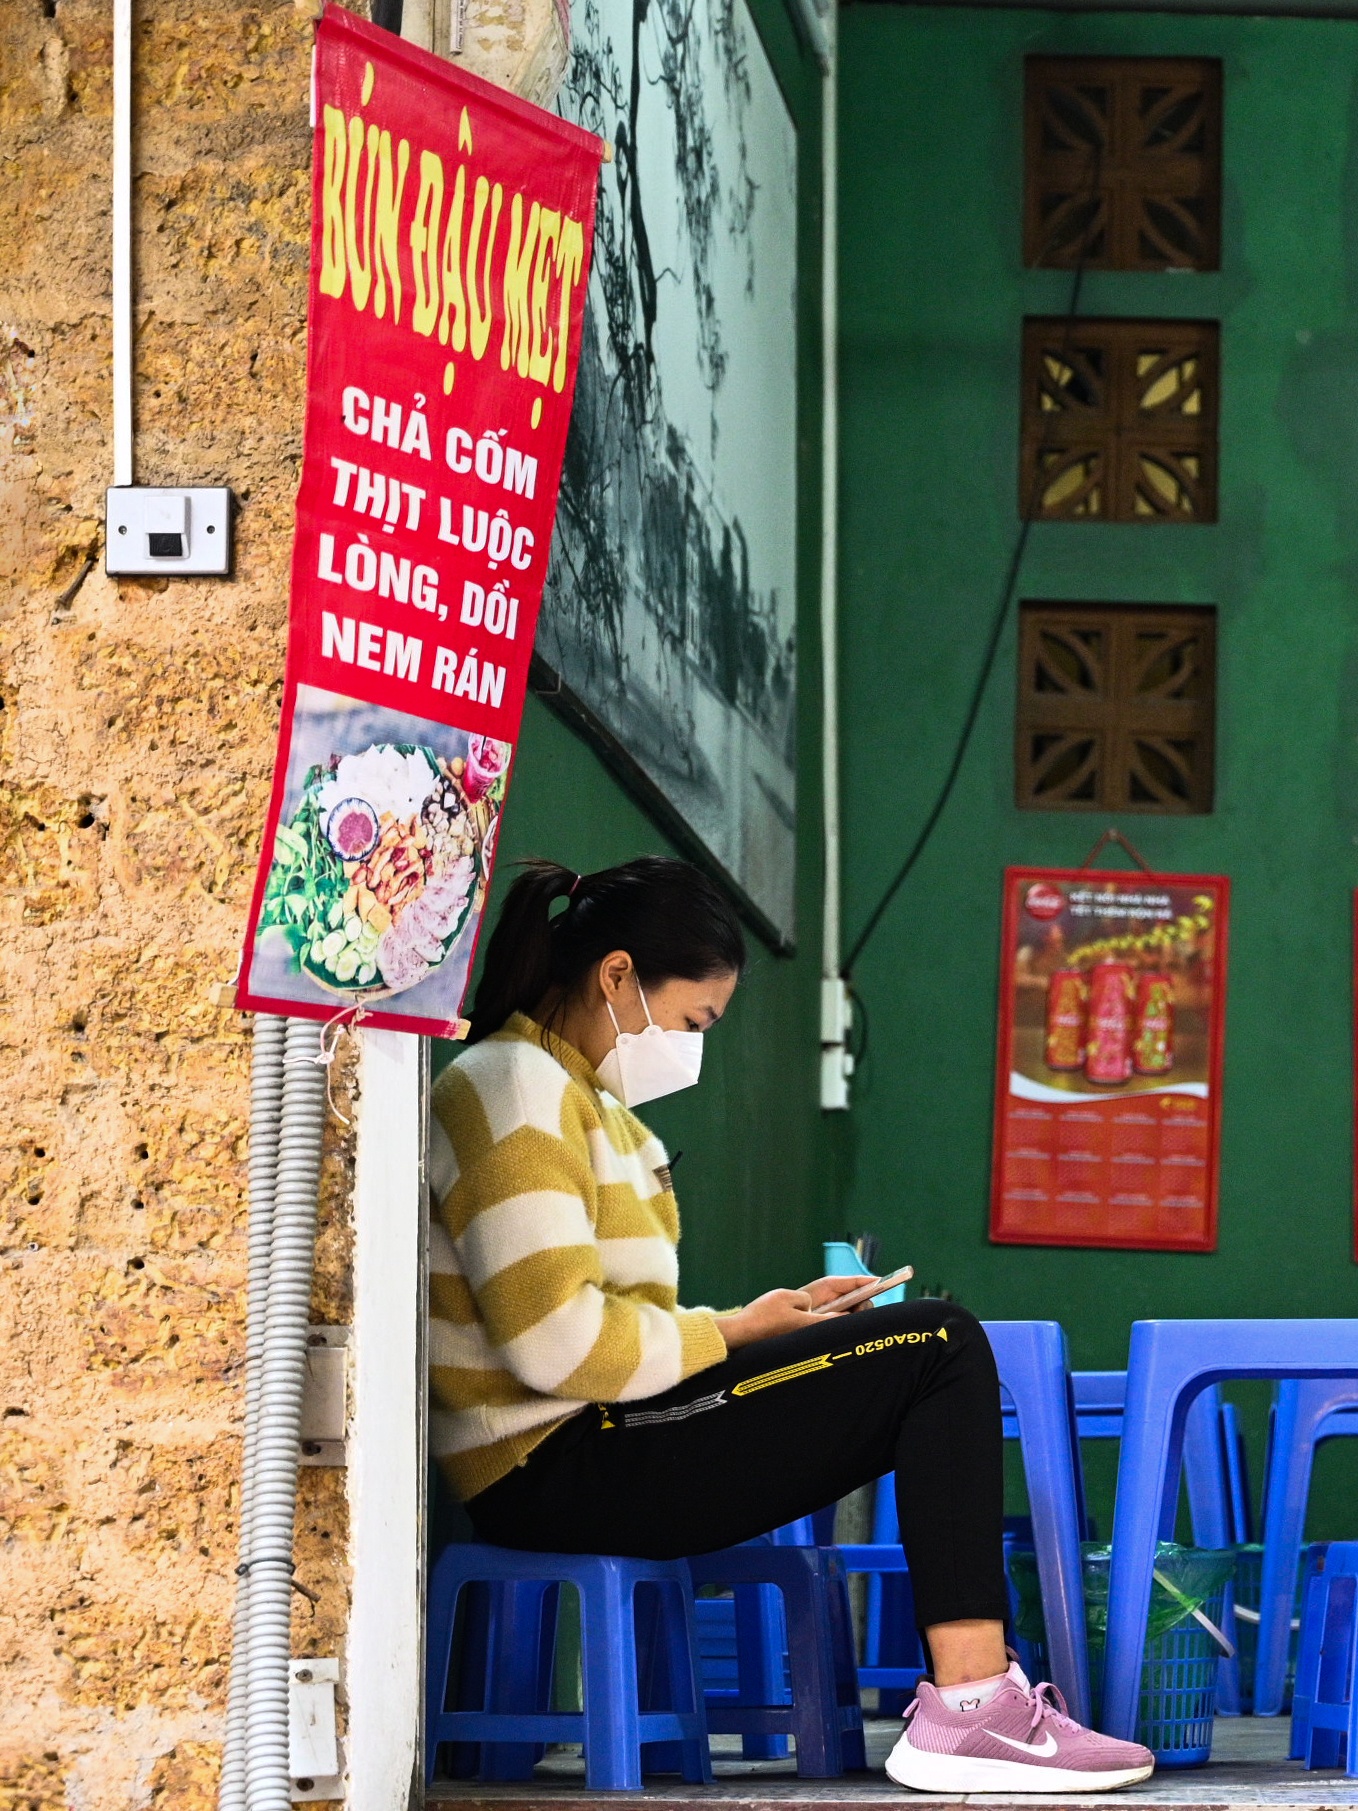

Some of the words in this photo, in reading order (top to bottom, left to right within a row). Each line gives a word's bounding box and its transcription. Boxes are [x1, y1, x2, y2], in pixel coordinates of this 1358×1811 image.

[319, 62, 410, 326] BÚN
[411, 105, 503, 396] ĐẬU
[502, 192, 584, 430] MẸT
[342, 386, 432, 461] CHẢ
[446, 428, 538, 500] CỐM
[331, 457, 427, 534] THỊT
[437, 497, 535, 571] LUỘC
[318, 534, 449, 622] LÒNG,
[460, 580, 520, 641] DỒI
[322, 612, 423, 683] NEM
[432, 646, 507, 710] RÁN
[855, 1332, 933, 1356] JGA0520
